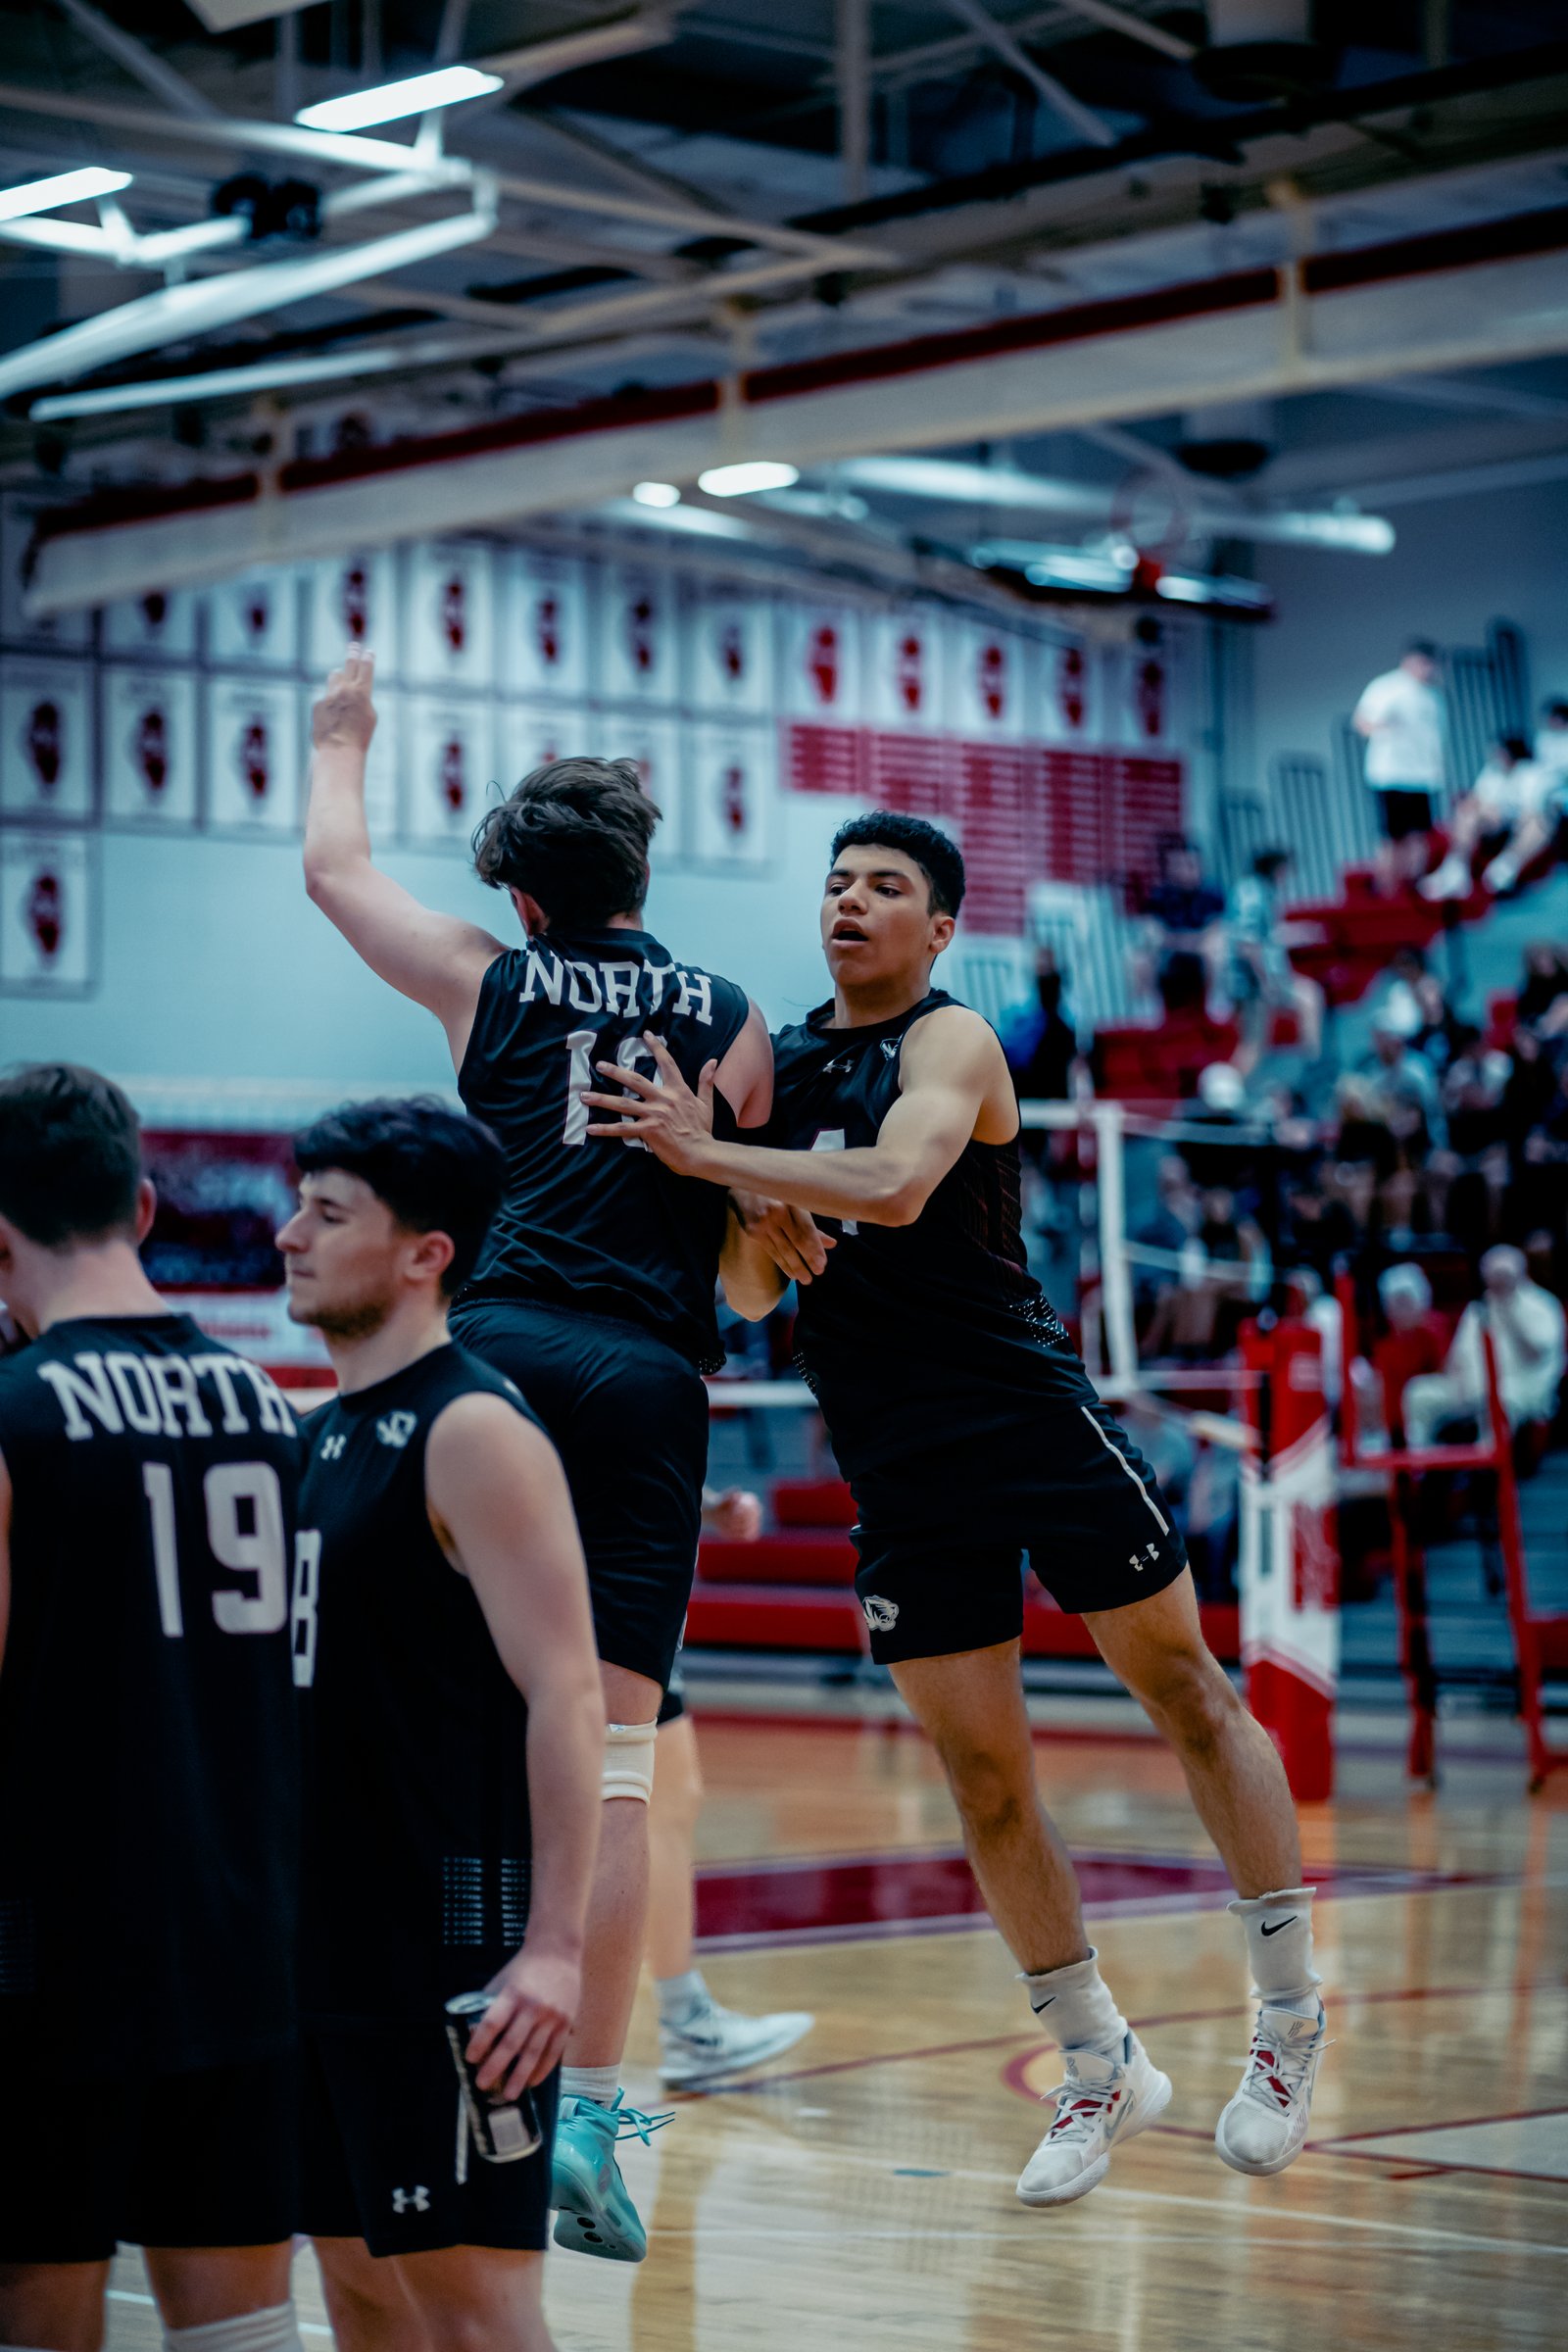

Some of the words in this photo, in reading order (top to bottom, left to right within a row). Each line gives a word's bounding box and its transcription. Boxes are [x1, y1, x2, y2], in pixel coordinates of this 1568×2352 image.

[519, 948, 713, 1026] NORTH
[37, 1351, 298, 1442] NORTH
[142, 1460, 287, 1638] 19
[290, 1528, 322, 1689] 8
